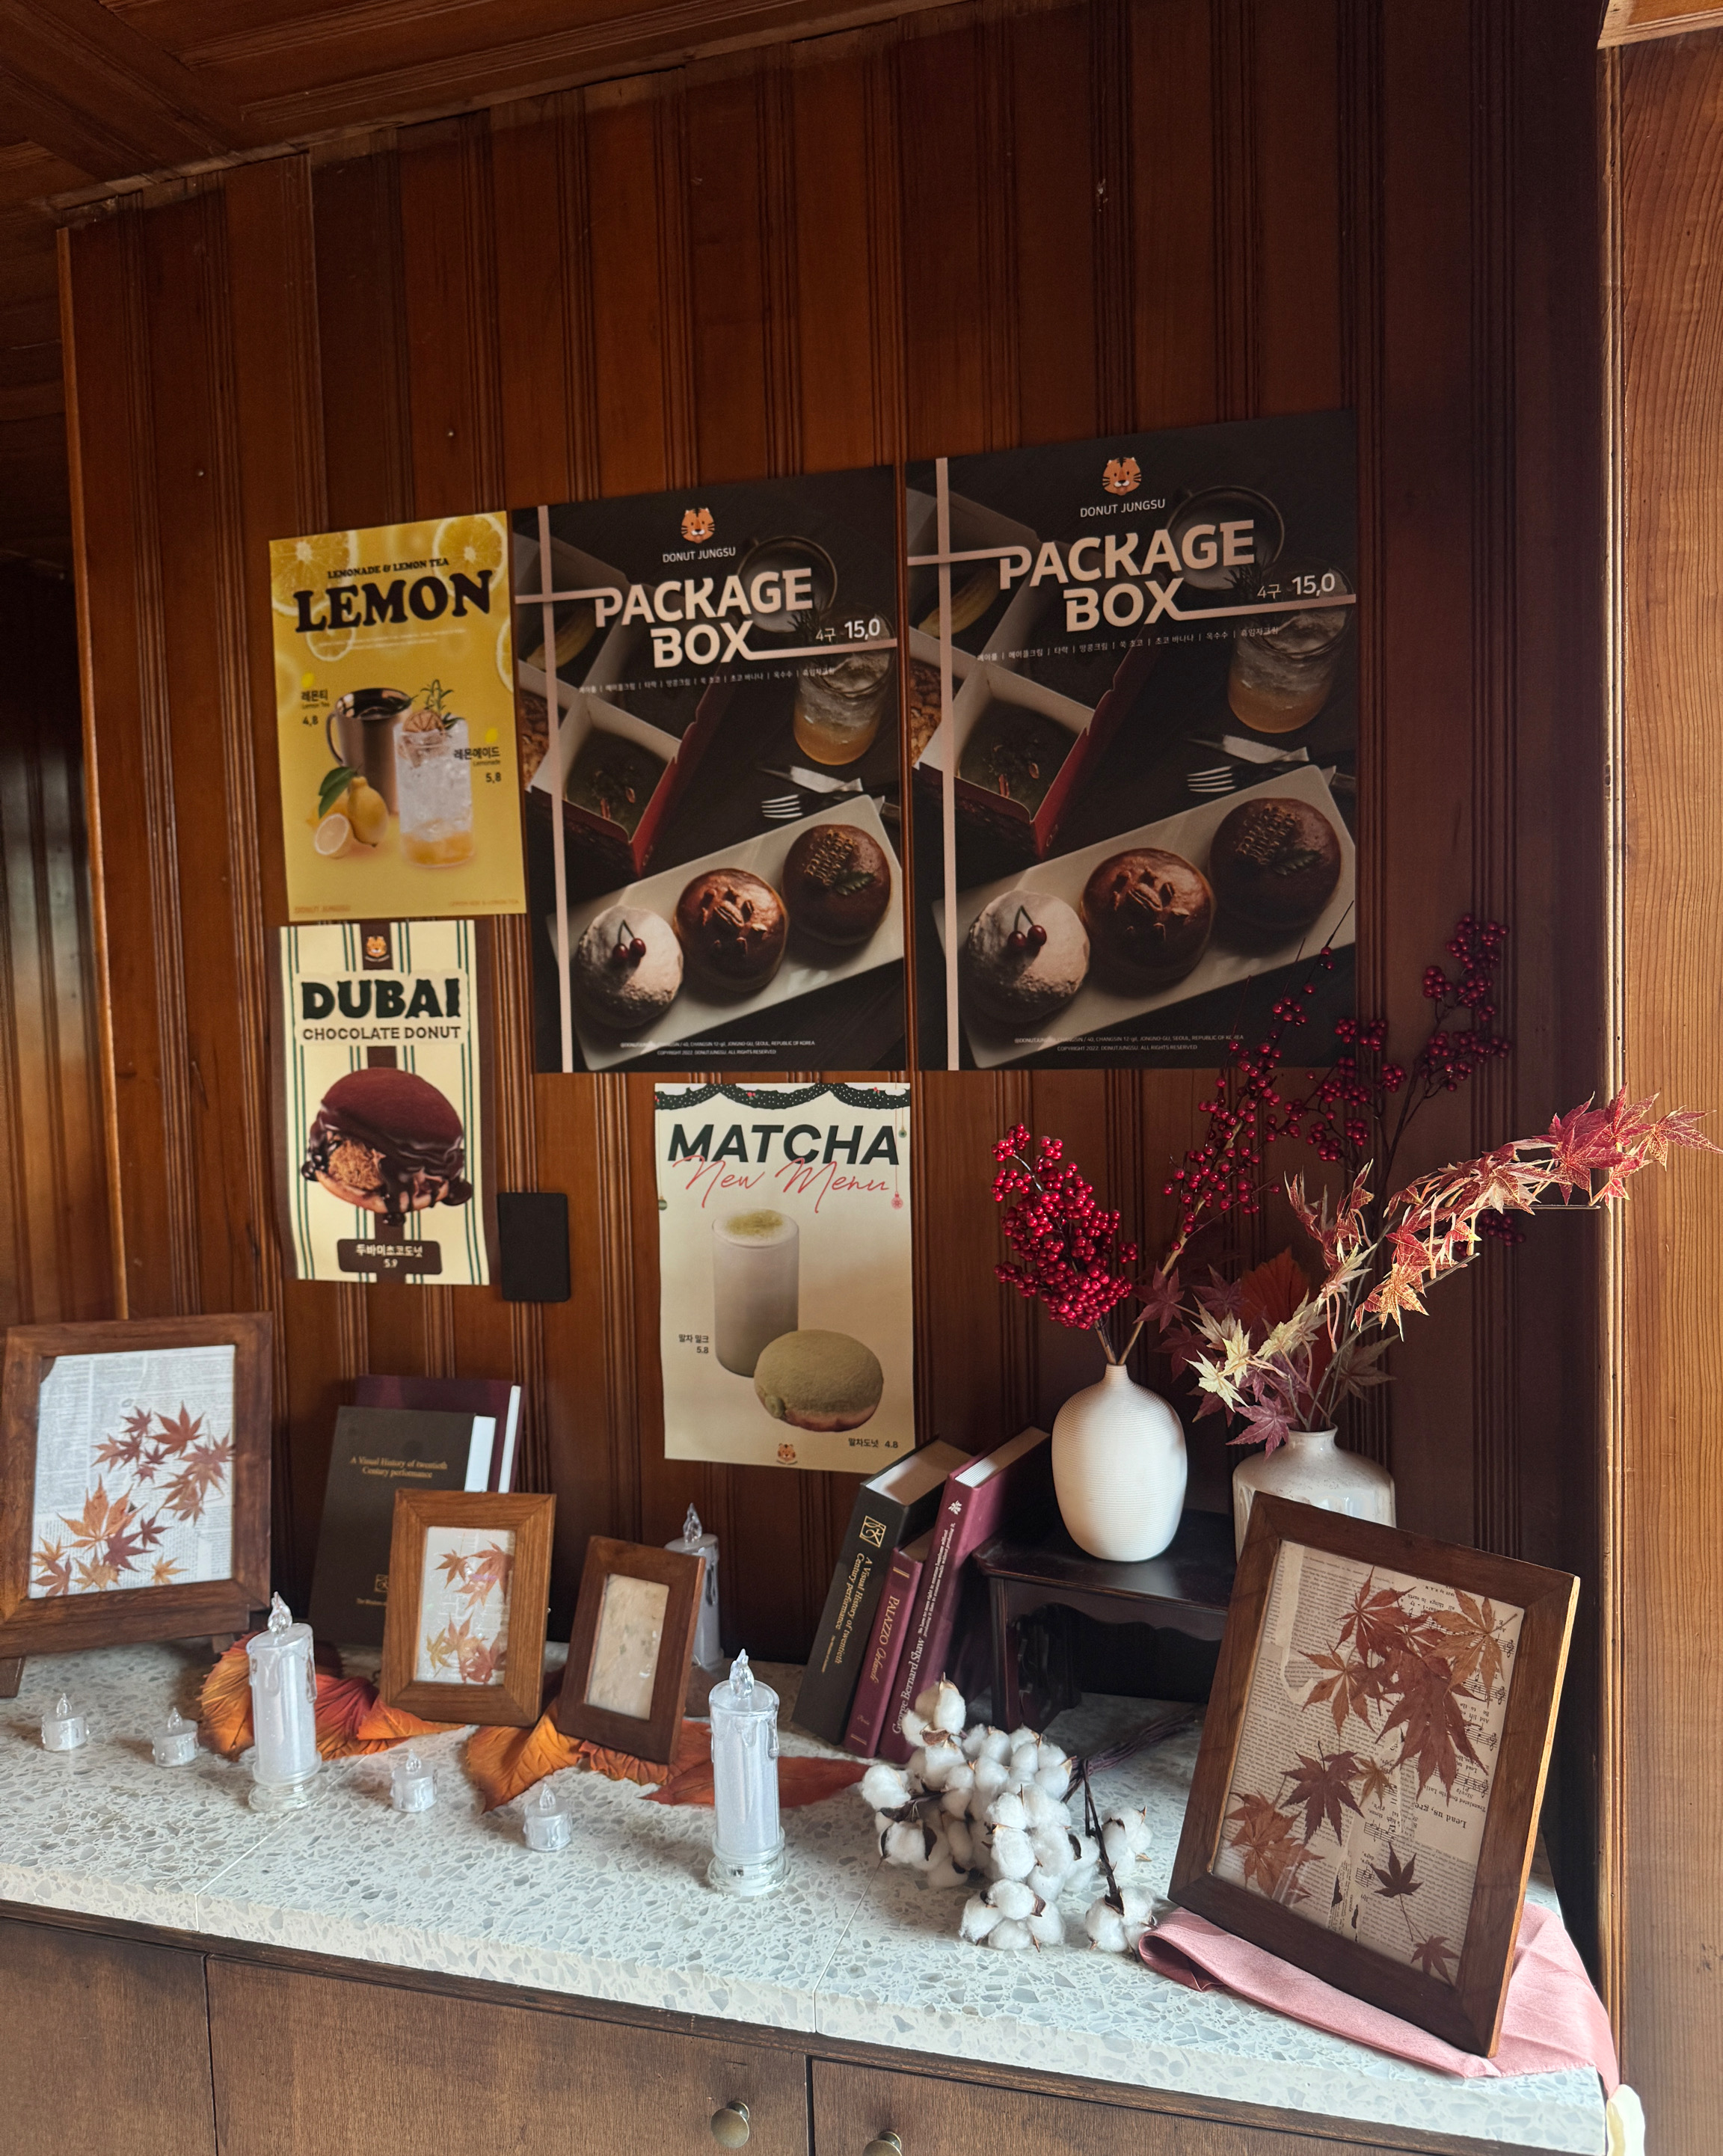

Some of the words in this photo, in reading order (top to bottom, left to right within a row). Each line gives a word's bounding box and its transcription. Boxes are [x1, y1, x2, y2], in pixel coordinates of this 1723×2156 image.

[1080, 503, 1119, 518] DONUT
[1120, 498, 1166, 514] JUNGSU
[662, 551, 695, 564] DONUT
[697, 547, 737, 560] JUNGSU
[999, 519, 1255, 591] PACKAGE
[327, 565, 381, 580] LEMONADE
[393, 560, 428, 572] LEMON
[429, 558, 449, 568] TEA
[595, 567, 814, 628] PACKAGE
[1256, 583, 1282, 600] 4구
[1291, 572, 1336, 597] 15,0
[292, 569, 493, 633] LEMON
[1063, 577, 1185, 633] BOX
[815, 627, 837, 642] 4구
[844, 618, 881, 641] 15,0
[650, 620, 755, 669] BOX
[301, 689, 328, 701] 레몬티
[453, 746, 500, 760] 레몬에이드
[301, 977, 461, 1020] DUBAI
[303, 1027, 400, 1040] CHOCOLATE
[404, 1026, 461, 1039] DONUT
[668, 1123, 900, 1165] MATCHA
[672, 1154, 765, 1208] New
[775, 1157, 890, 1214] Menu
[356, 1244, 423, 1258] 두바이초코도넛
[678, 1334, 694, 1343] 말차
[695, 1335, 710, 1344] 밀크
[848, 1437, 879, 1449] 말차도넛
[885, 1440, 899, 1449] 4.8
[848, 1552, 865, 1583] Century
[864, 1556, 873, 1565] A
[857, 1567, 871, 1591] Visual
[835, 1582, 854, 1630] performance
[847, 1590, 864, 1620] History
[845, 1619, 853, 1631] of
[879, 1595, 900, 1645] PALAZZO
[834, 1630, 851, 1665] twentieth
[900, 1661, 918, 1701] Bernard
[910, 1637, 925, 1663] Shaw
[1414, 1802, 1429, 1812] gre
[1431, 1807, 1443, 1818] us,
[1459, 1799, 1486, 1813] Translated
[1446, 1814, 1466, 1828] Lead
